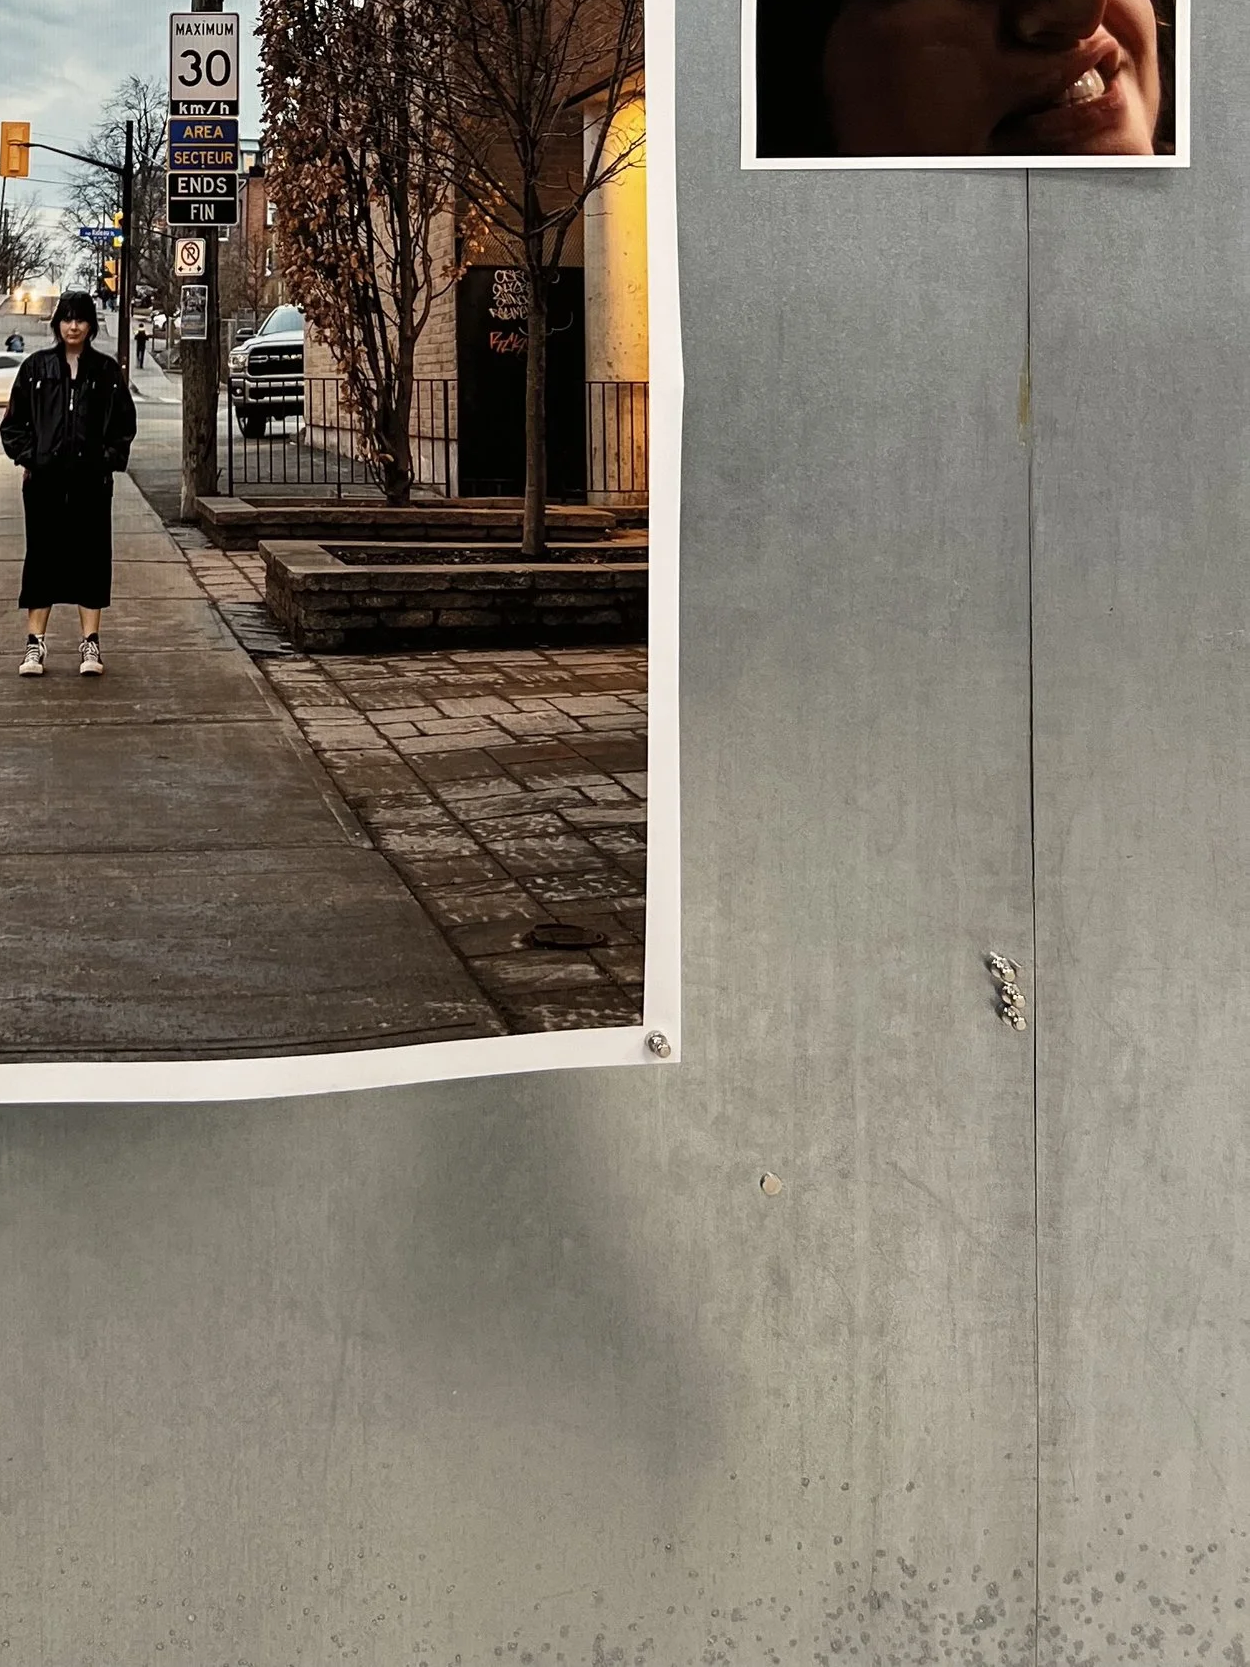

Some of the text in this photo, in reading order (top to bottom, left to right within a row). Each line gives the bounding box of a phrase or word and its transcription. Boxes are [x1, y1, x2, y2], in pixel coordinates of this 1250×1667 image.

[176, 23, 234, 36] MAXIMUM
[178, 49, 231, 87] 30
[179, 101, 230, 115] km/h
[183, 125, 224, 139] AREA
[174, 151, 234, 165] SECTEUR
[178, 177, 228, 194] ENDS
[190, 203, 215, 221] FIN
